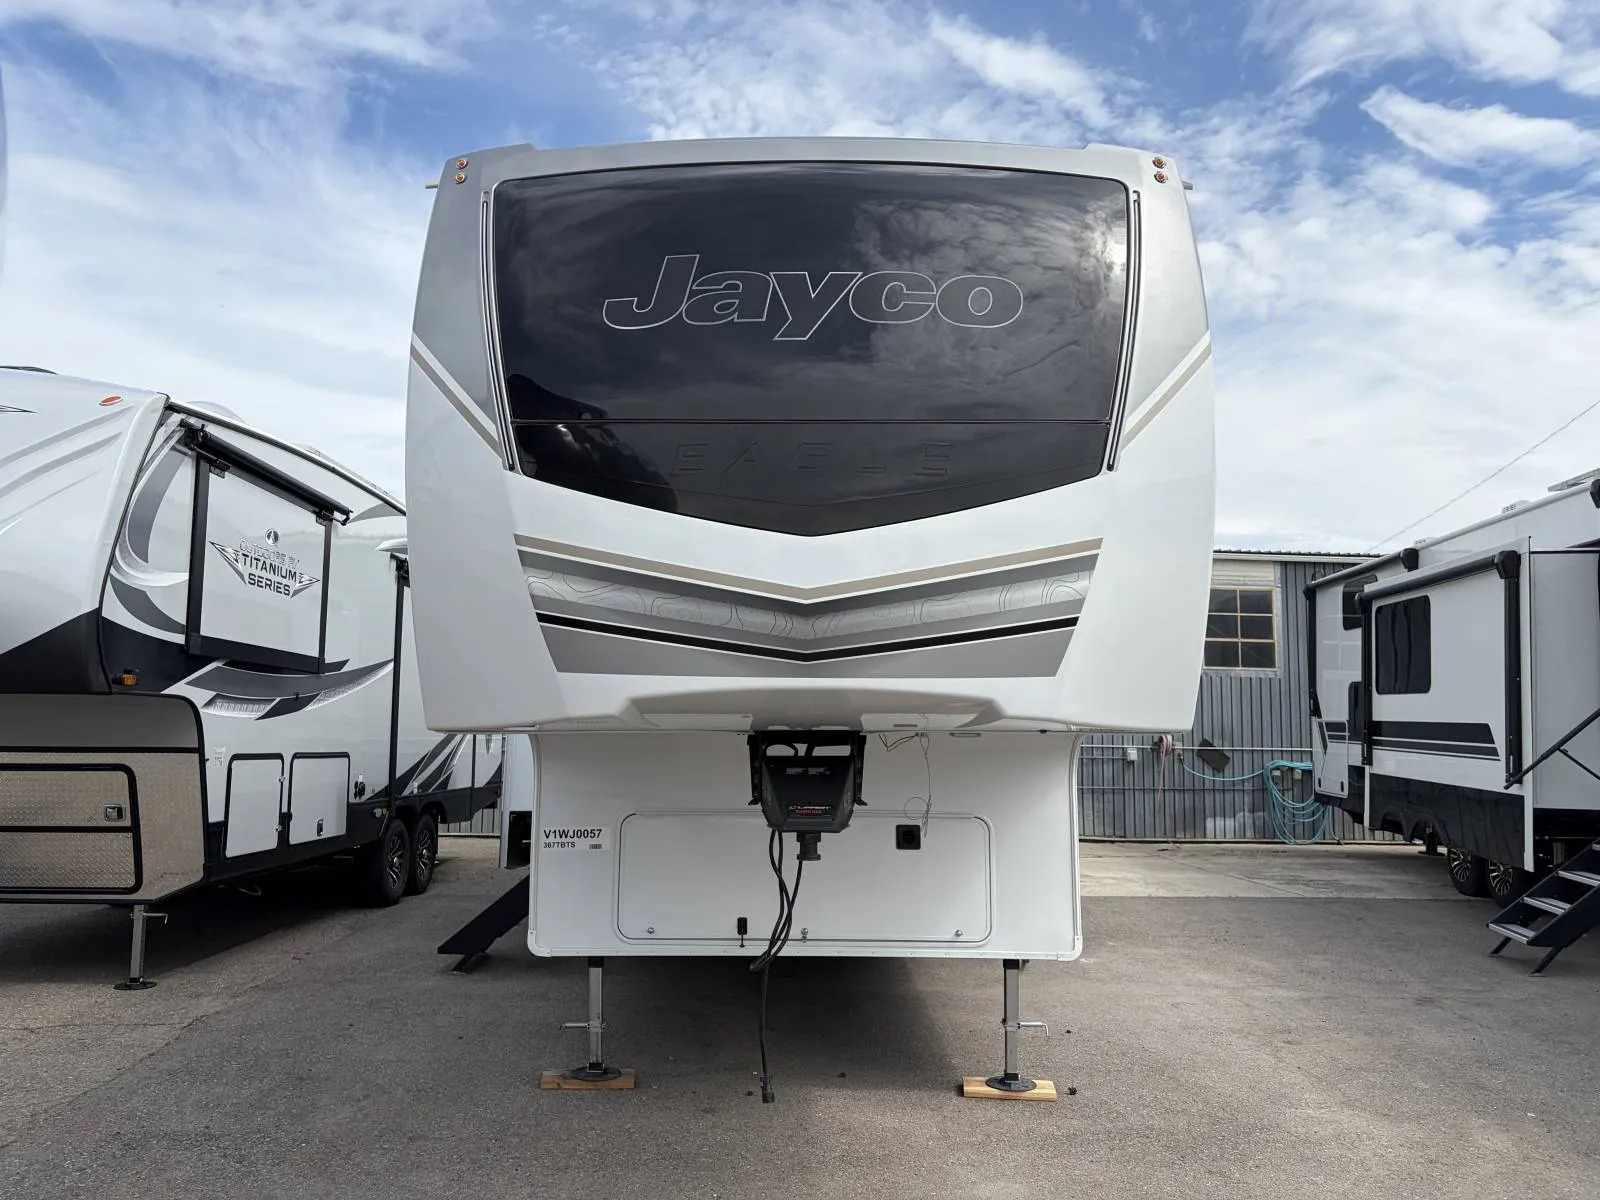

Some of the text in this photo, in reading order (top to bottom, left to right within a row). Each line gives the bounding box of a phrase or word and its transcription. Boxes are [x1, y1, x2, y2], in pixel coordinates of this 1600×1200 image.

[603, 254, 1023, 340] Jayco
[242, 553, 297, 582] TITANIUM
[248, 572, 291, 597] SERIES
[543, 828, 602, 839] V1WJ0057
